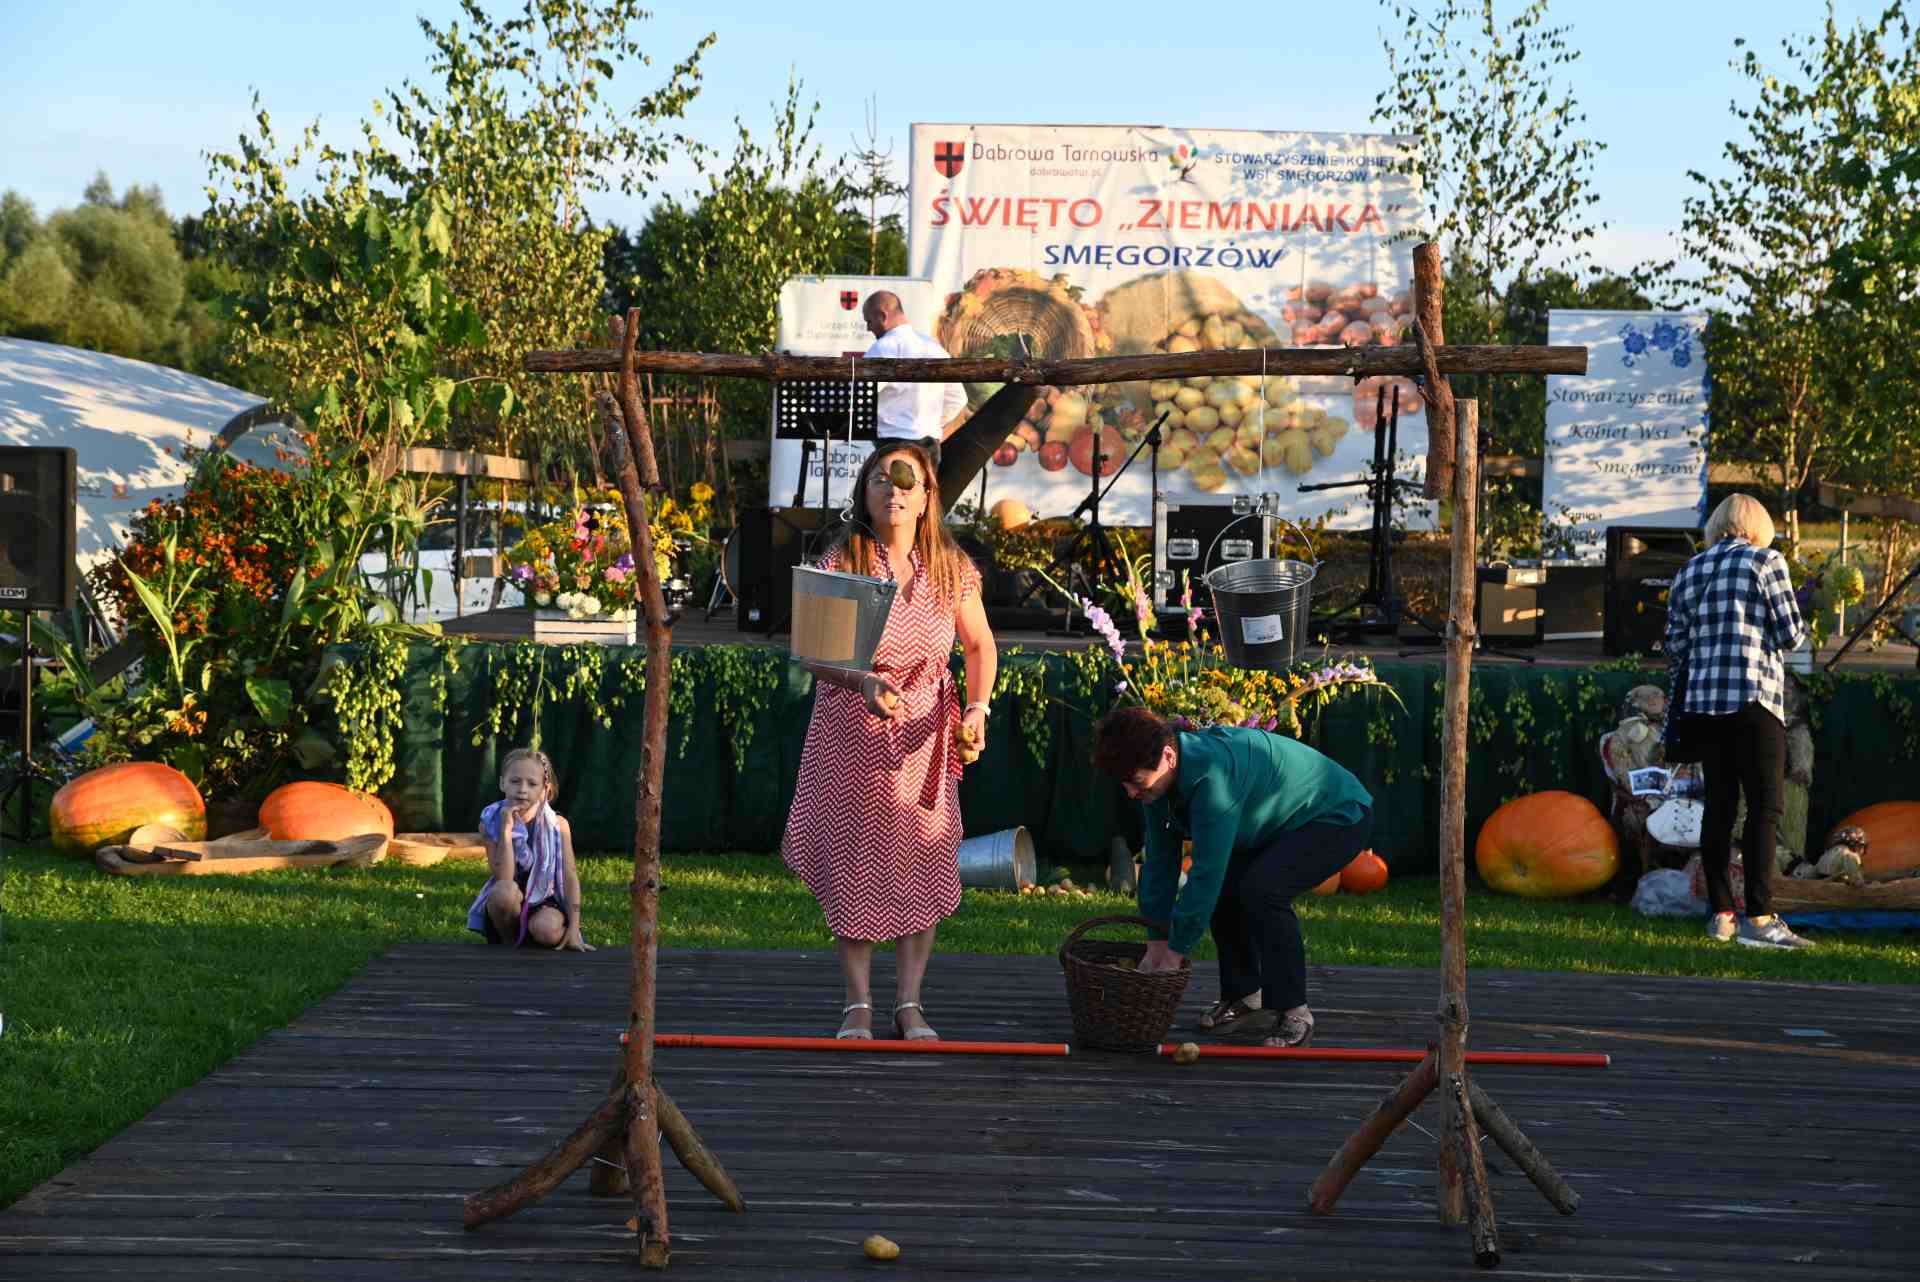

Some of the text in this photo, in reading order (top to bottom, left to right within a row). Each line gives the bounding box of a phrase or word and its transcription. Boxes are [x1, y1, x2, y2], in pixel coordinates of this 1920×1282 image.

[972, 142, 1158, 166] Dąbrowa Tarnowska
[1214, 152, 1338, 167] STOWARZYSZENIE
[930, 188, 1104, 233] ŚWIĘTO
[1043, 242, 1284, 270] SMĘGORZÓW
[1551, 387, 1697, 409] Stowarzyszenie
[1567, 423, 1630, 440] Kobiet
